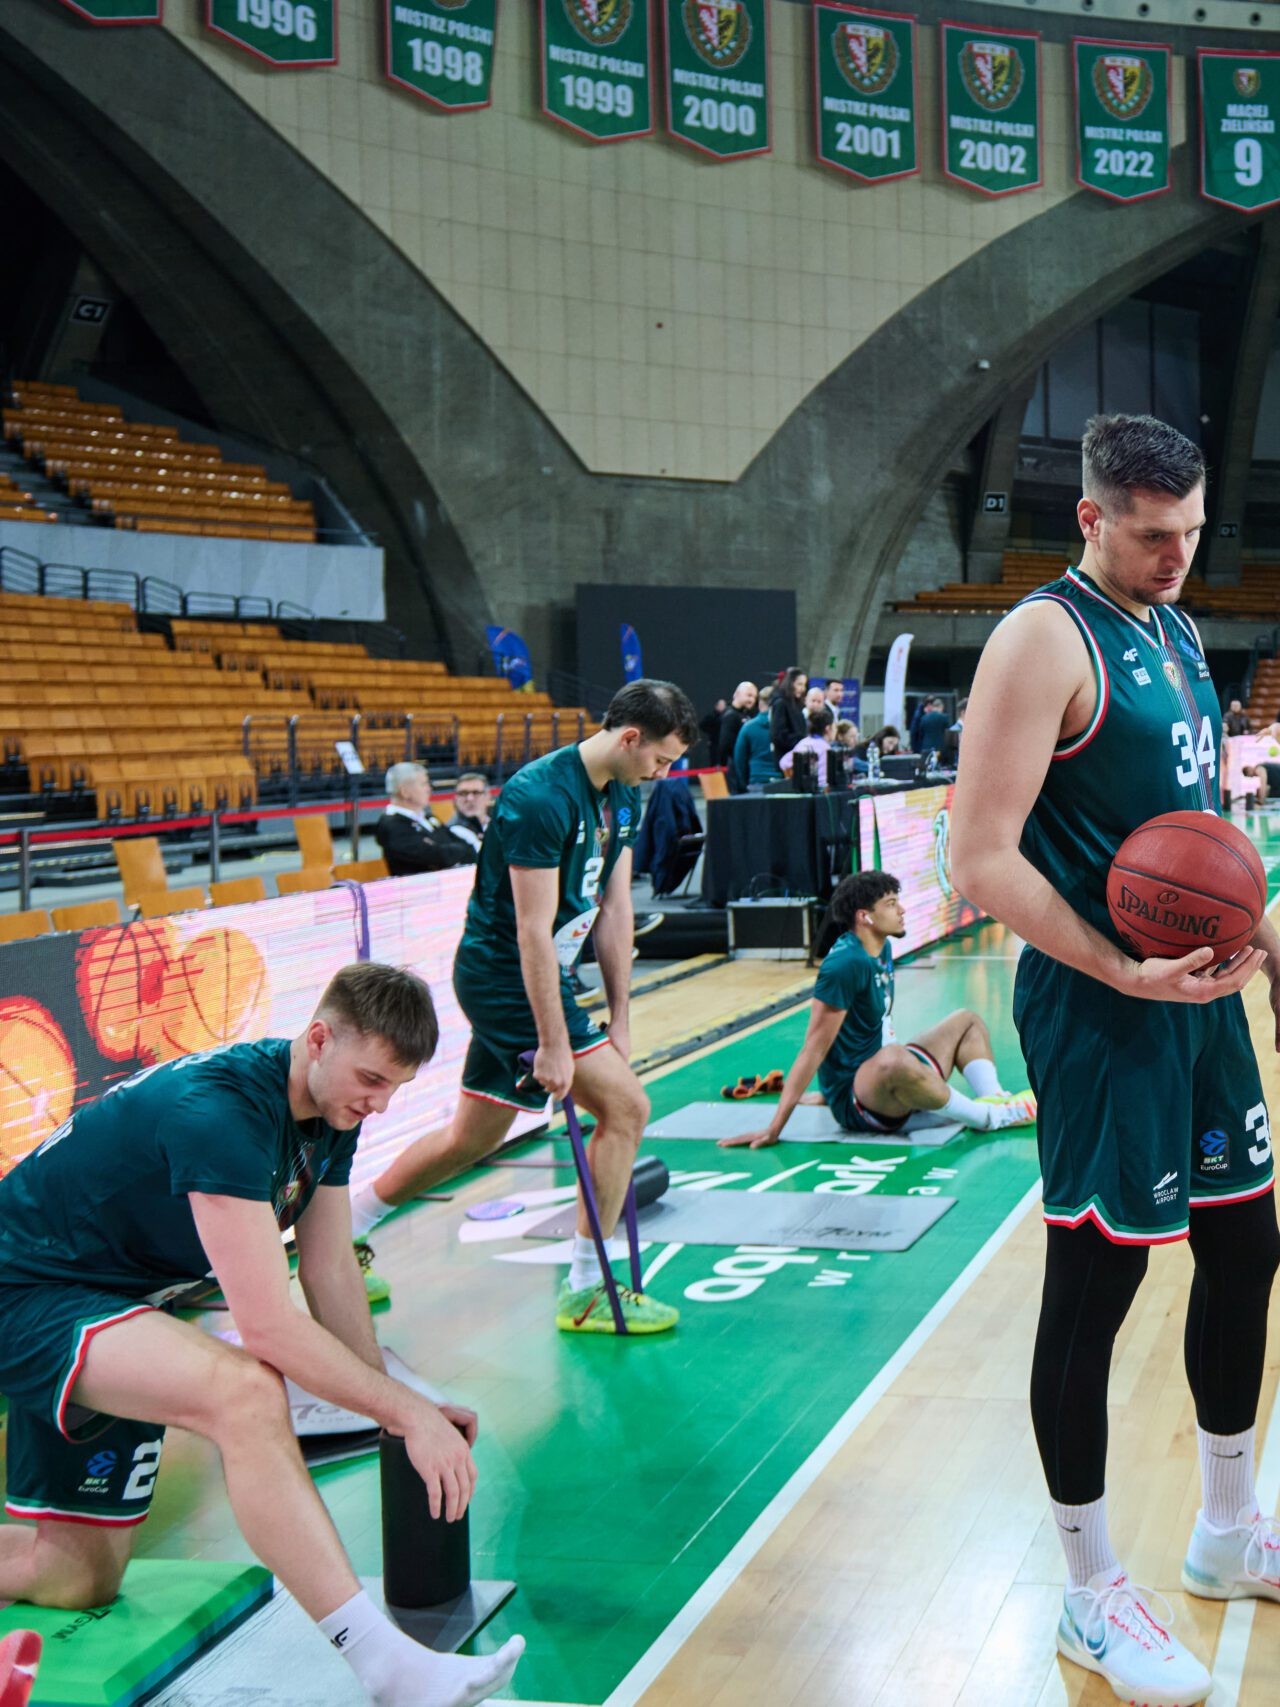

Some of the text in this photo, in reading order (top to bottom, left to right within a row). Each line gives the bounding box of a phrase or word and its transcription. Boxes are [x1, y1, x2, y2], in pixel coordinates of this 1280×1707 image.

[237, 0, 317, 42] 1996
[395, 6, 493, 46] MISTRZ POLSKI
[407, 38, 483, 86] 1998
[549, 44, 645, 78] MISTRZ POLSKI
[560, 74, 634, 118] 1999
[673, 68, 764, 98] MISTRZ POLSKI
[684, 95, 756, 136] 2000
[823, 97, 911, 122] MISTRZ POLSKI
[950, 115, 1035, 138] MISTRZ POLSKI
[835, 122, 901, 160] 2001
[1085, 126, 1162, 143] MISTRZ POLSKI
[959, 139, 1026, 175] 2002
[1094, 148, 1154, 178] 2022
[1234, 138, 1263, 187] 9
[79, 304, 103, 318] C1
[986, 497, 1004, 508] D1
[1172, 715, 1216, 788] 34
[581, 856, 604, 898] 2
[1117, 884, 1221, 939] SPALDING
[1245, 1101, 1272, 1166] 3
[1200, 1163, 1228, 1171] EuroCup
[1153, 1187, 1179, 1199] WROCLAW
[1155, 1193, 1177, 1205] AIRPORT
[122, 1438, 162, 1500] 2
